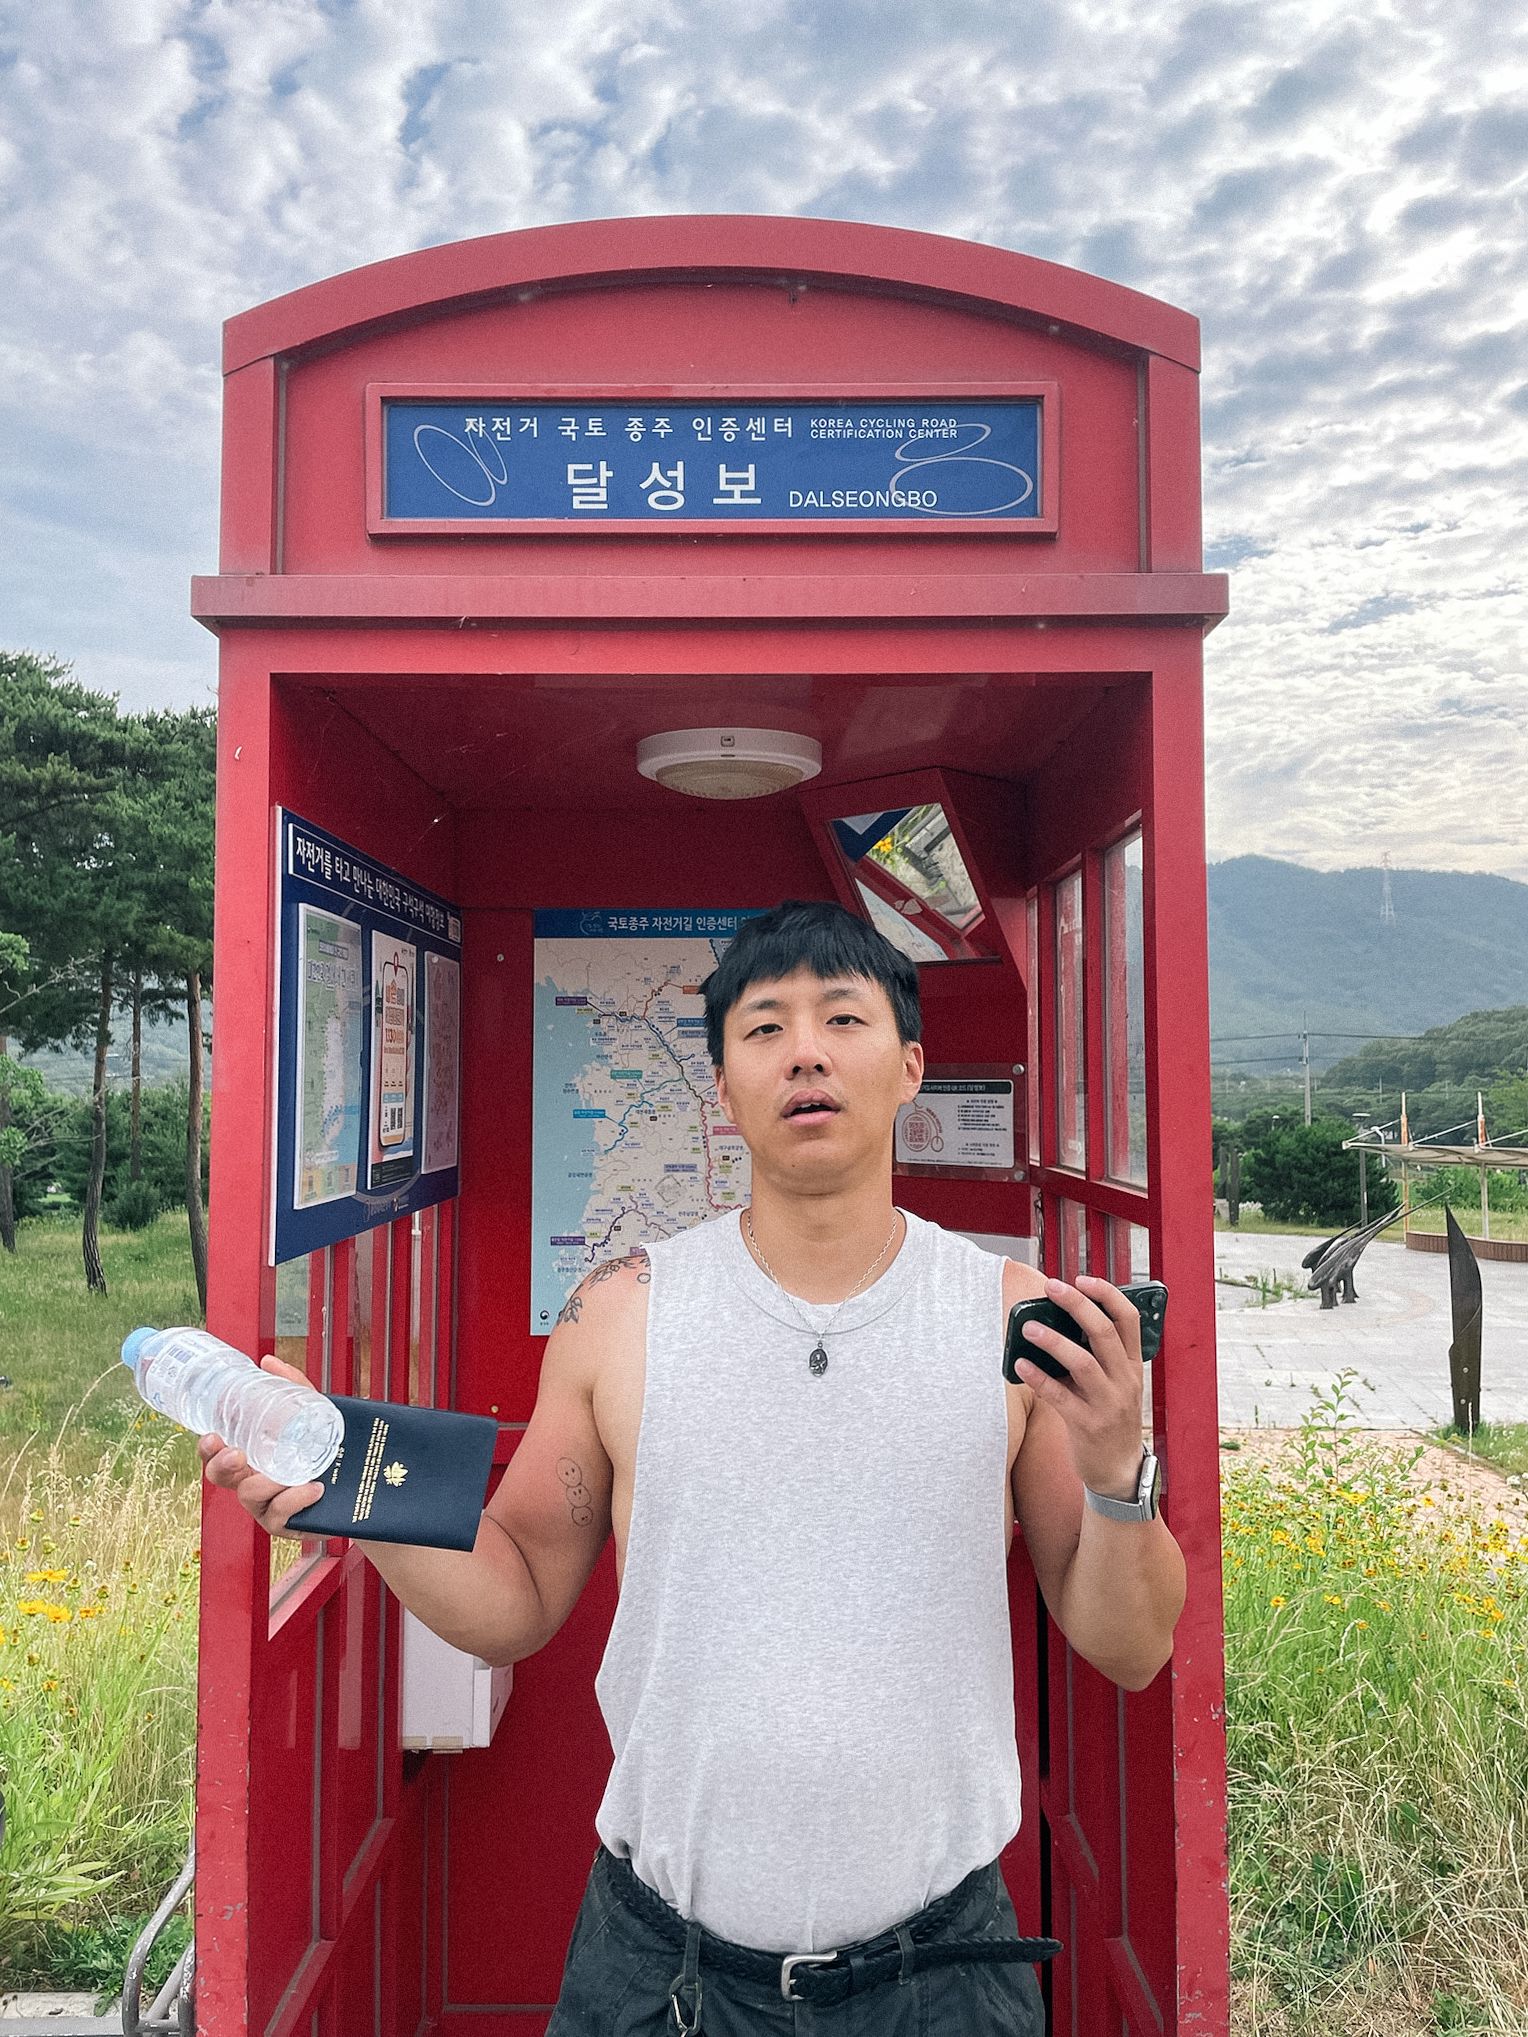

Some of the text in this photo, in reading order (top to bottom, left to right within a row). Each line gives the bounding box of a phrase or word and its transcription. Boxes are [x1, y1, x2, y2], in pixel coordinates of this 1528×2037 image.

[464, 416, 793, 442] 자전거 국토 종주 인증센터
[810, 418, 957, 428] KOREA CYCLING ROAD
[810, 428, 958, 439] CERTIFICATION CENTER
[567, 460, 762, 511] 달성보
[789, 490, 938, 508] DALSEONGBO
[296, 836, 333, 880] 자전거를
[334, 856, 351, 882] 타고
[352, 865, 374, 900] 만나는
[375, 877, 401, 913] 대한민국
[607, 916, 650, 931] 국토종주
[652, 916, 693, 931] 자전거길
[696, 916, 738, 931] 인증센터
